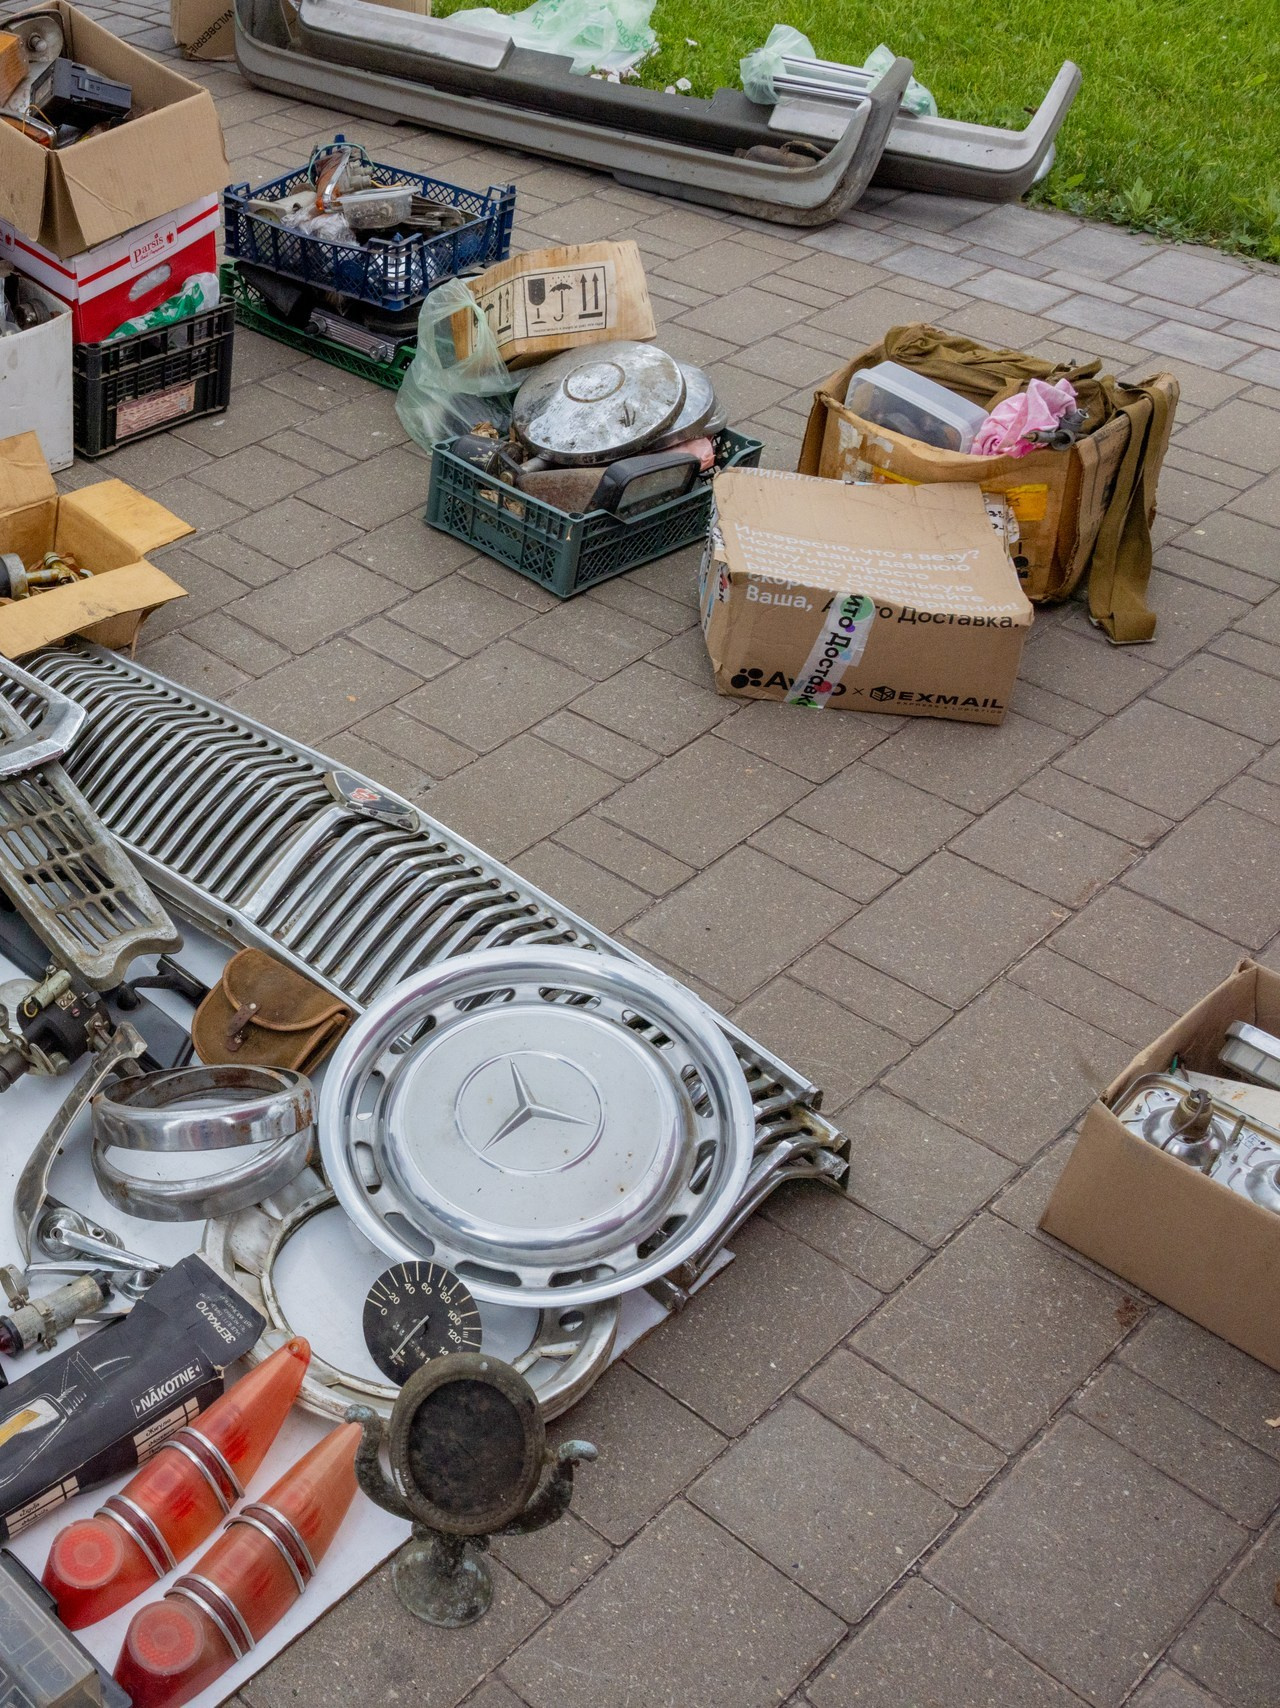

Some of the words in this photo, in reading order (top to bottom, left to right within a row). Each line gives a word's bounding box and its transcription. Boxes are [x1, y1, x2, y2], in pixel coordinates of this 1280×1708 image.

[734, 522, 857, 554] Интересно,
[859, 547, 897, 559] что
[901, 552, 913, 560] я
[918, 549, 980, 563] везу?
[737, 532, 811, 557] Может,
[815, 550, 873, 566] вашу
[878, 559, 971, 572] давнюю
[739, 542, 801, 563] мечту
[807, 558, 846, 569] или
[851, 564, 929, 580] просто
[847, 572, 974, 594] маленькую
[847, 579, 986, 603] Открывайте
[745, 584, 814, 613] Ваша,
[898, 604, 1020, 630] Доставка.
[763, 671, 847, 697] Avo
[897, 691, 1005, 710] EXMAIL
[388, 1292, 401, 1305] 20
[404, 1282, 416, 1295] 40
[420, 1282, 433, 1296] 60
[439, 1291, 452, 1305] 80
[195, 1300, 237, 1344] ЗЕРКАЛО
[380, 1307, 389, 1317] 0
[447, 1309, 462, 1326] 100
[447, 1328, 462, 1344] 120
[140, 1366, 198, 1411] NĀKOTNE
